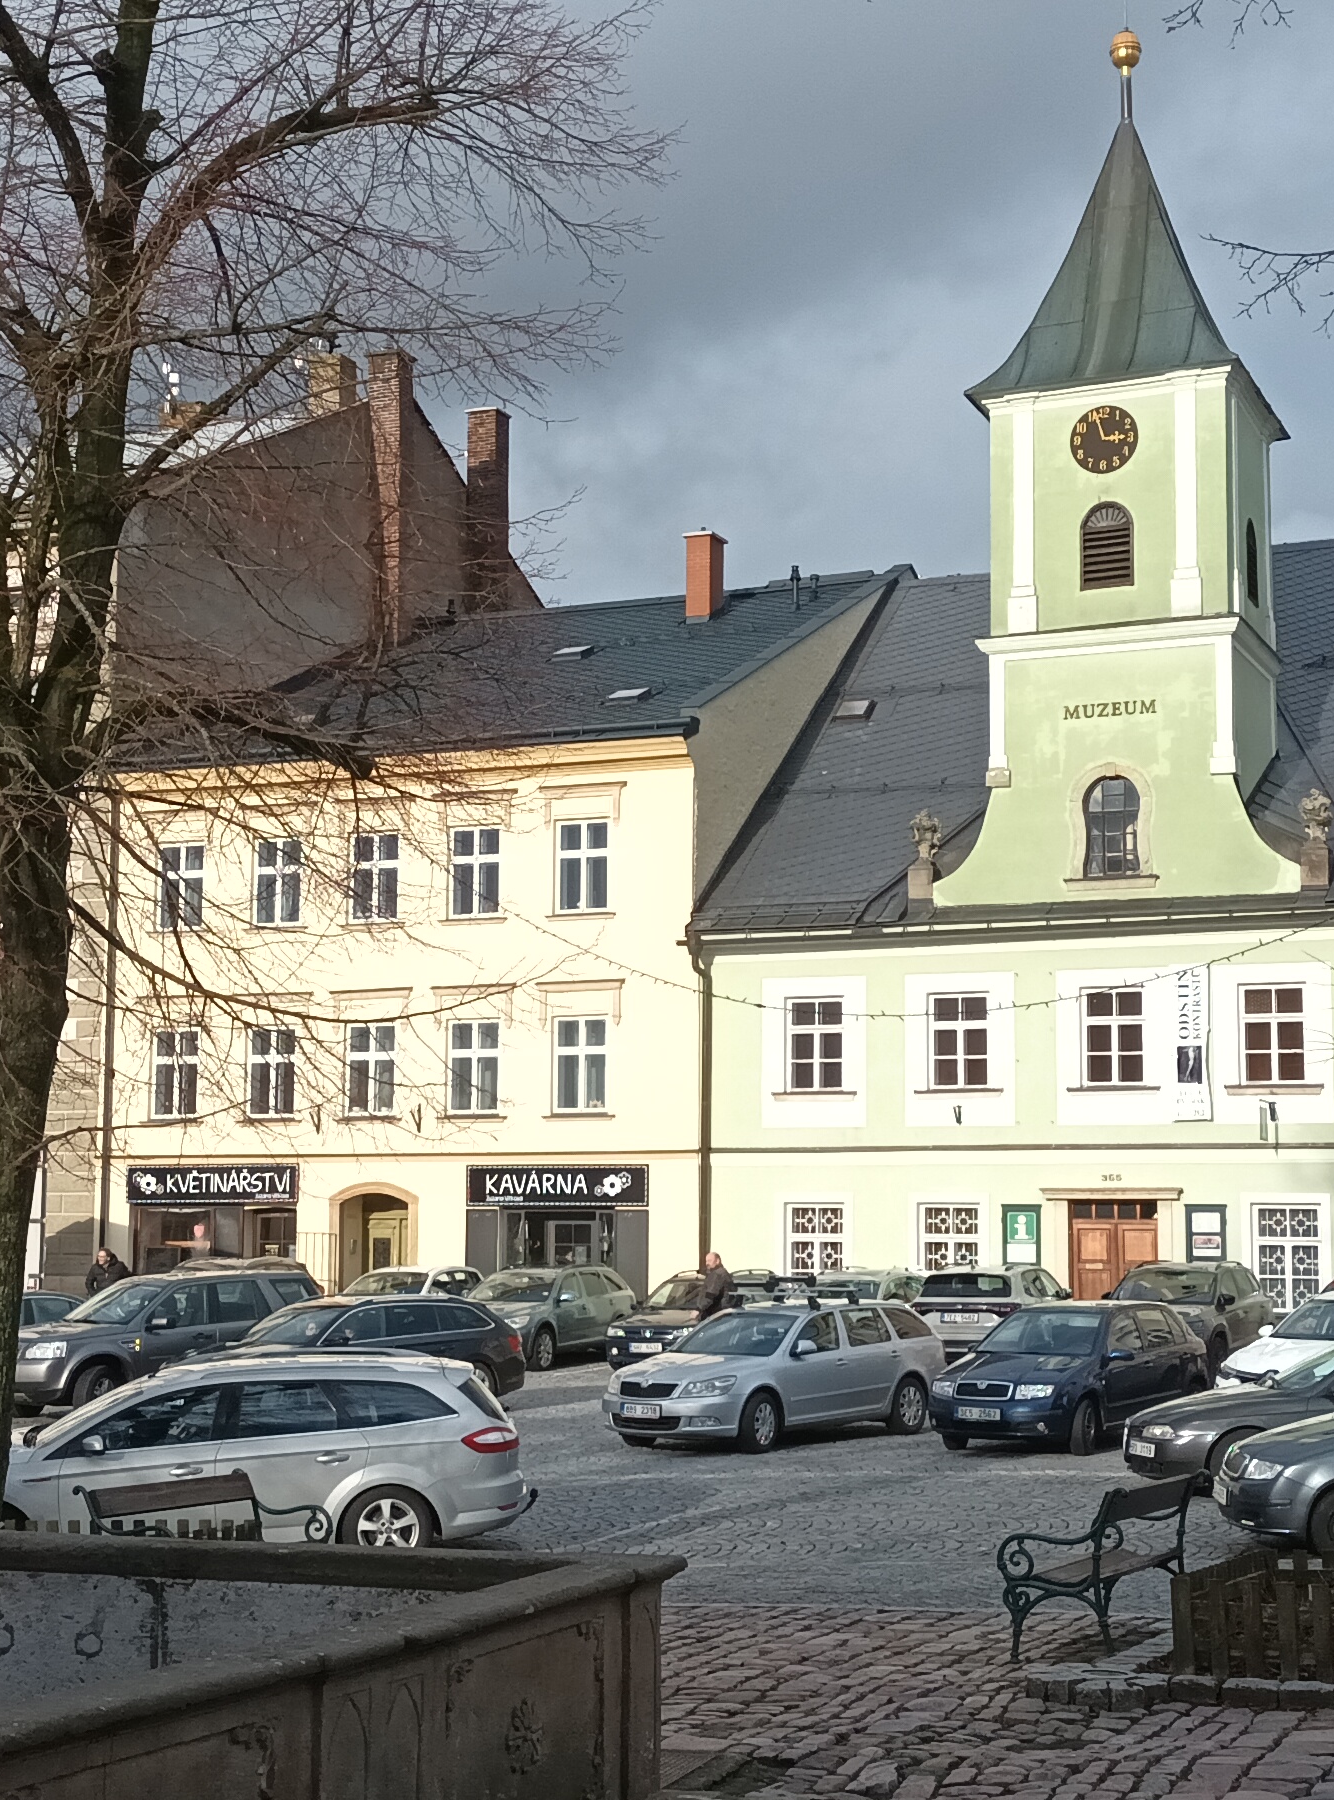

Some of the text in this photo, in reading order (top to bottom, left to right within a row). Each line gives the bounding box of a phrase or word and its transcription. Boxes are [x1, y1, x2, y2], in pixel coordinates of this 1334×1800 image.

[1063, 699, 1157, 720] MUZEUM
[166, 1169, 291, 1194] KVĚTINÁŘSTVÍ
[485, 1170, 588, 1195] KAVÁRNA
